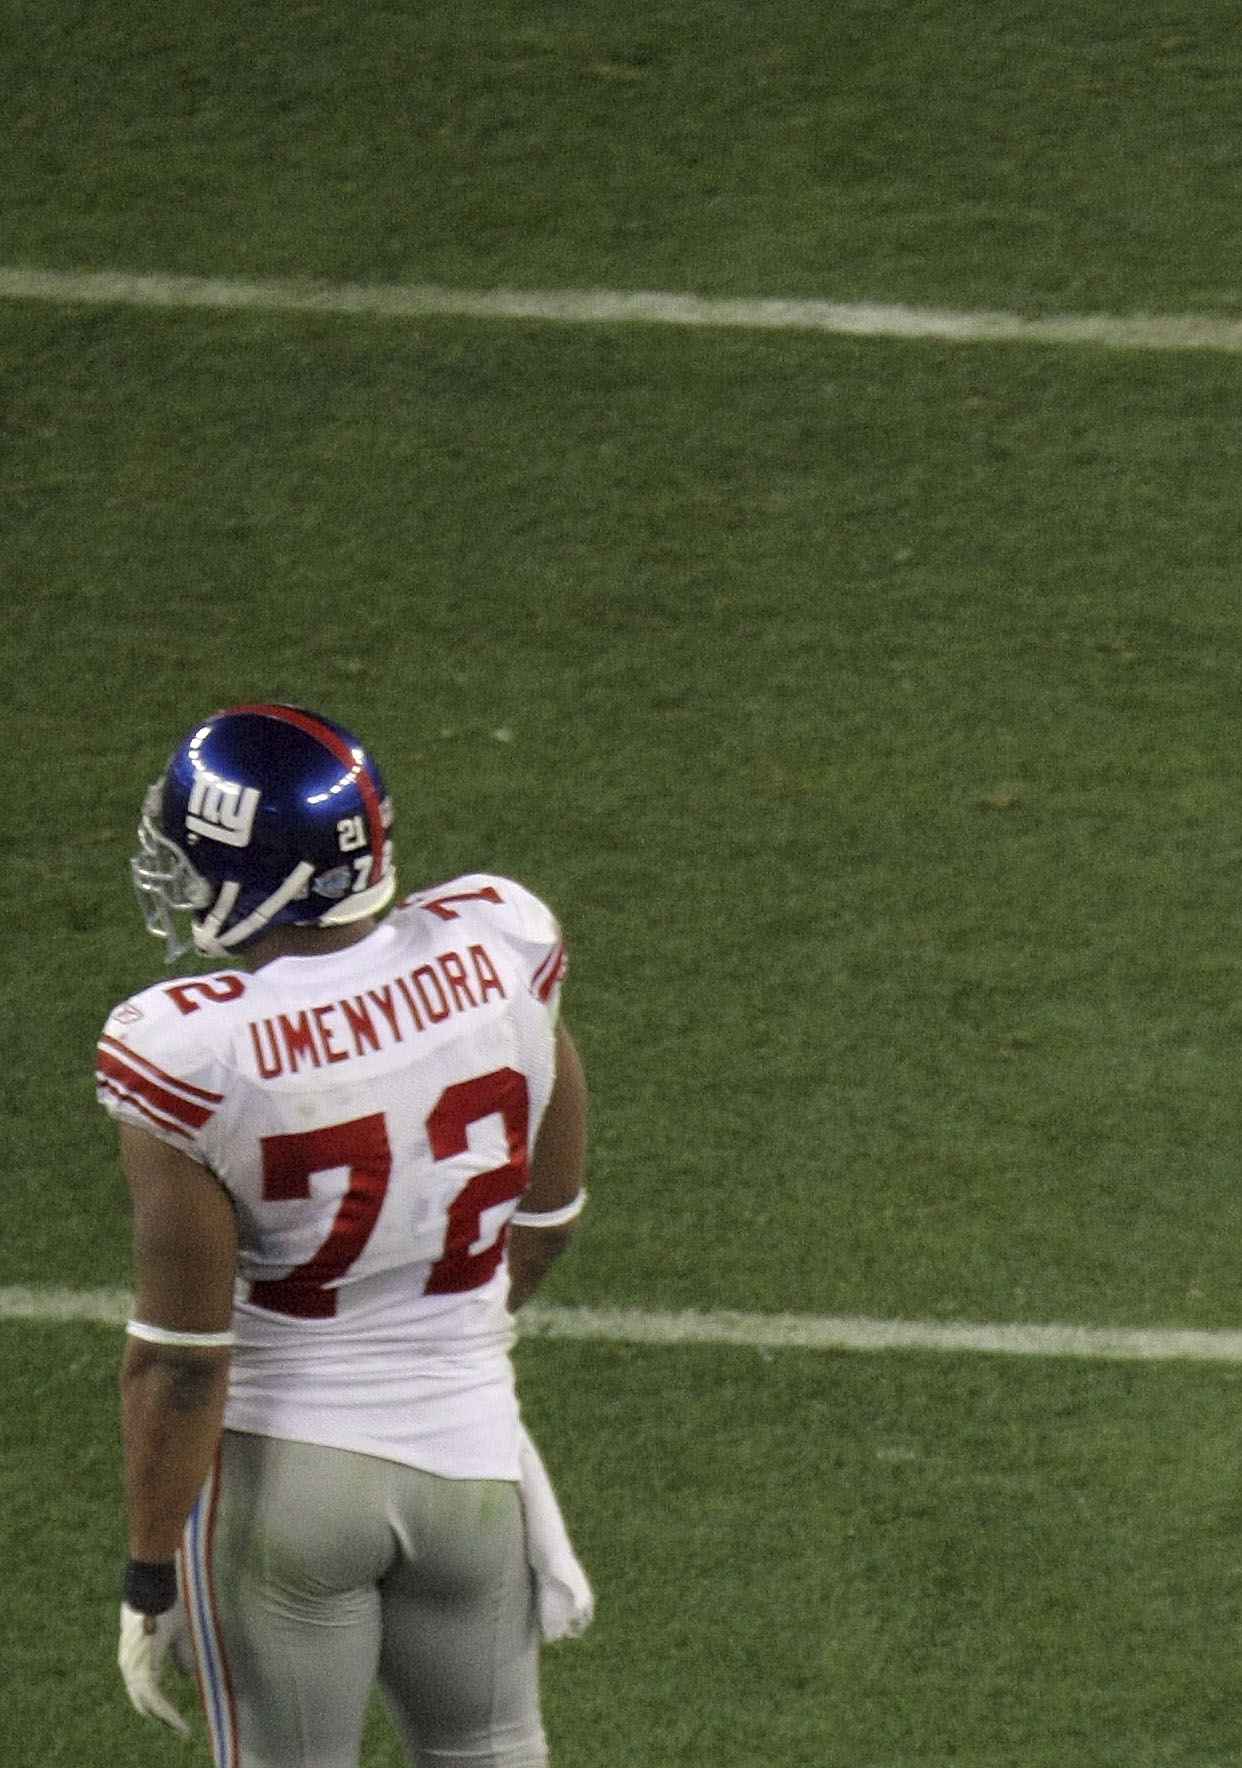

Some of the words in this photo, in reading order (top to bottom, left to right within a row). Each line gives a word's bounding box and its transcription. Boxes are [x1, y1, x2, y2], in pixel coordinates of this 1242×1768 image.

[336, 815, 368, 852] 21
[248, 944, 506, 1079] UMENYIORA
[249, 1066, 531, 1318] 72
